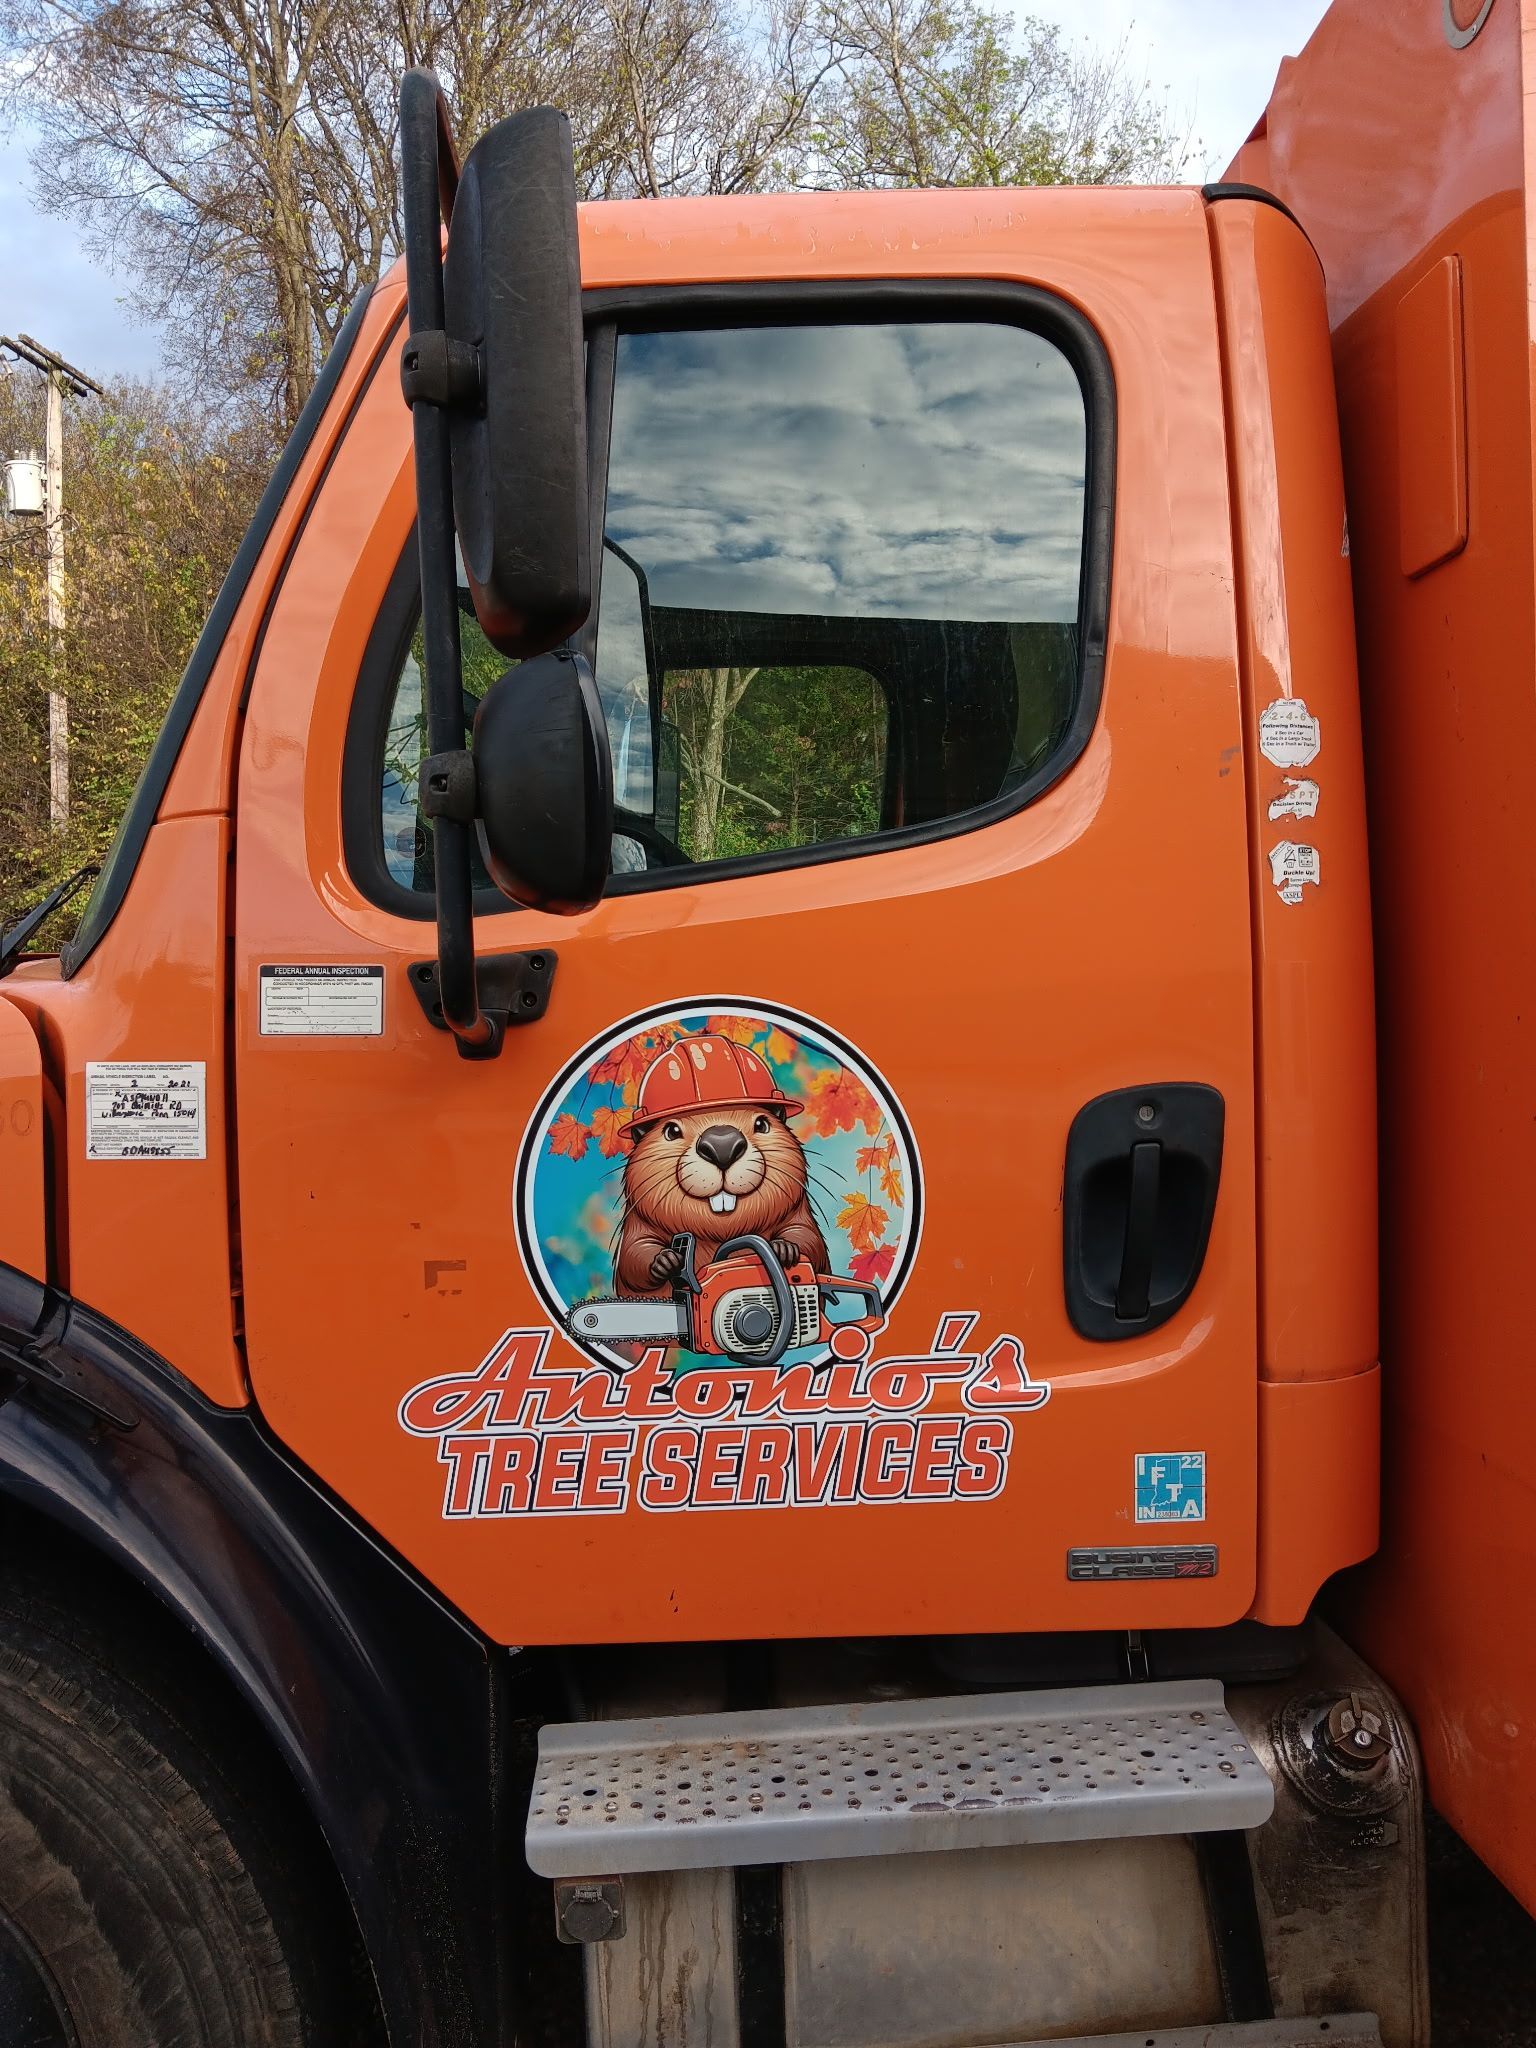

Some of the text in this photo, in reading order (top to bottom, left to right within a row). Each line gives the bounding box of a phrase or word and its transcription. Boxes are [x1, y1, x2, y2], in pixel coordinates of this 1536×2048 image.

[274, 967, 369, 975] FEDERAL ANNUAL INSPECTION
[399, 1312, 1049, 1437] Antonio's
[437, 1416, 1014, 1519] TREE SERVICES
[1181, 1456, 1202, 1469] 22
[1138, 1507, 1156, 1519] IN
[1071, 1550, 1215, 1565] BUSINESS
[1071, 1564, 1175, 1578] CLASS
